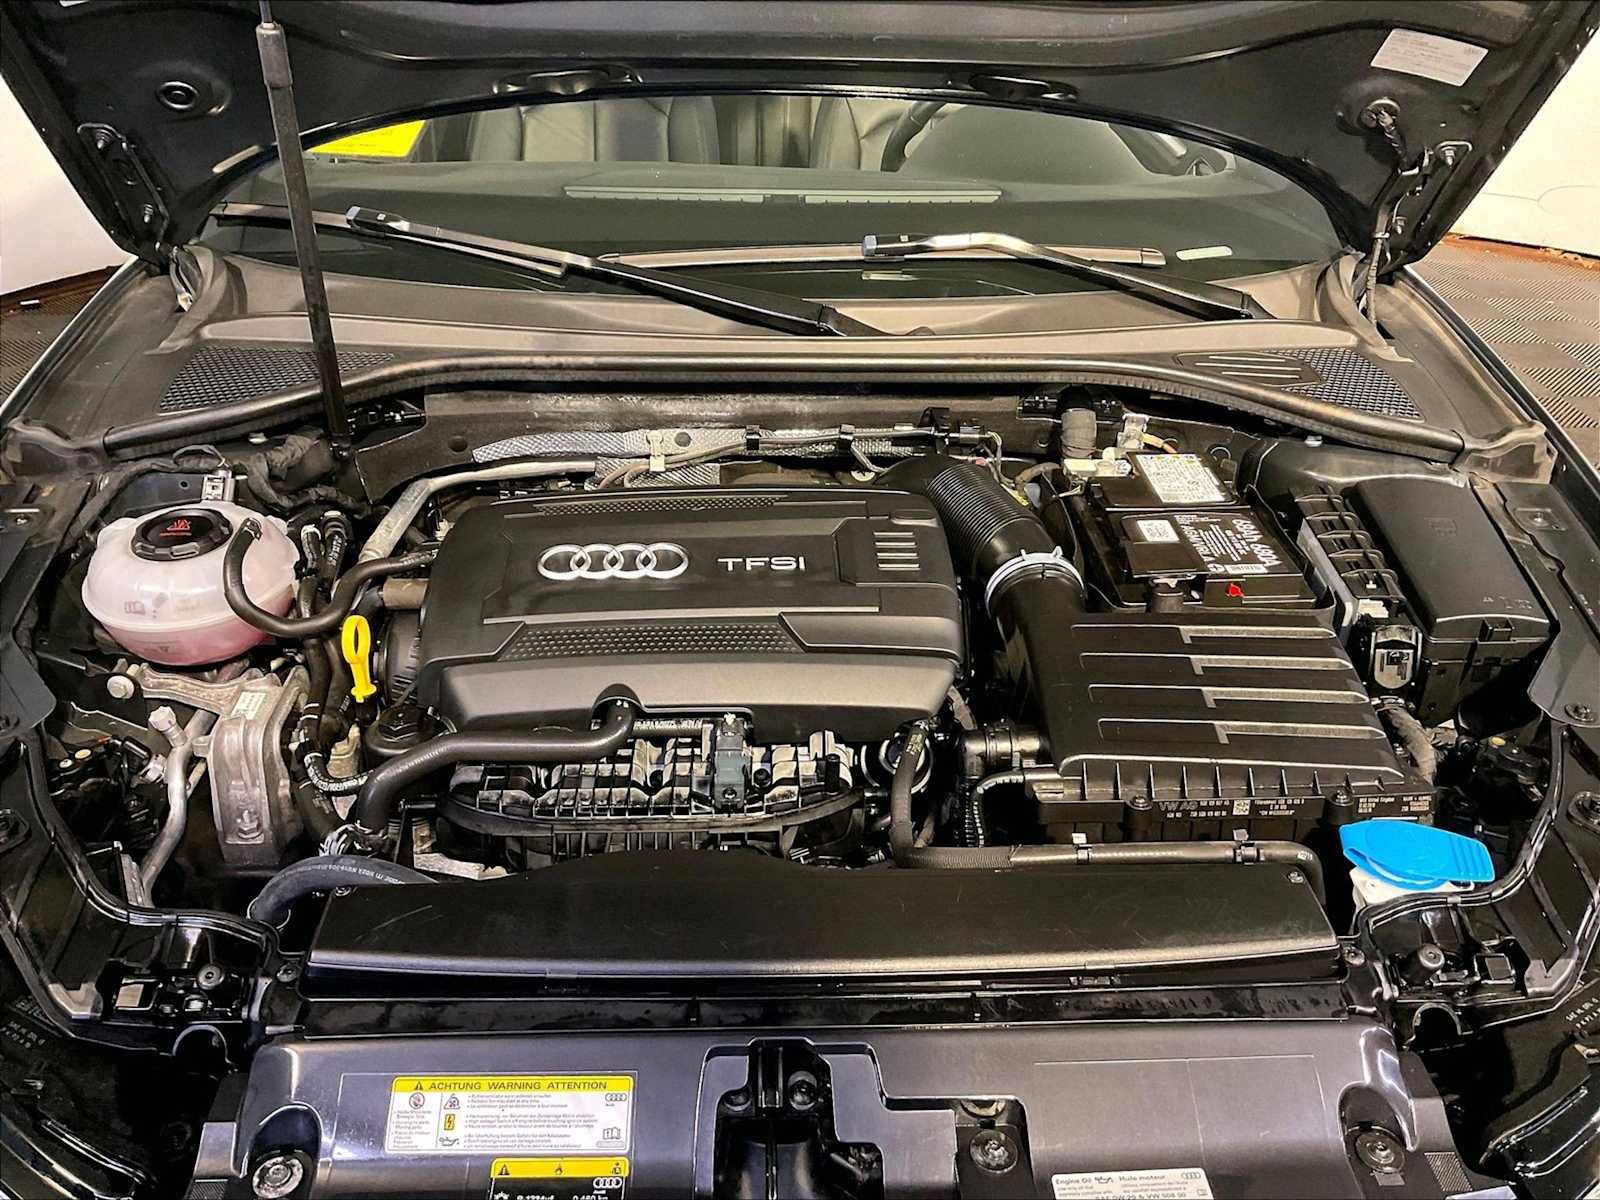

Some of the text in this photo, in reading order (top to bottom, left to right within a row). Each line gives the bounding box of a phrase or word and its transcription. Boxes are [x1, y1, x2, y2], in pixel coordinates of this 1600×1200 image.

[717, 556, 806, 572] TFSI
[429, 1081, 607, 1090] ACHTUNG WARNING ATTENTION
